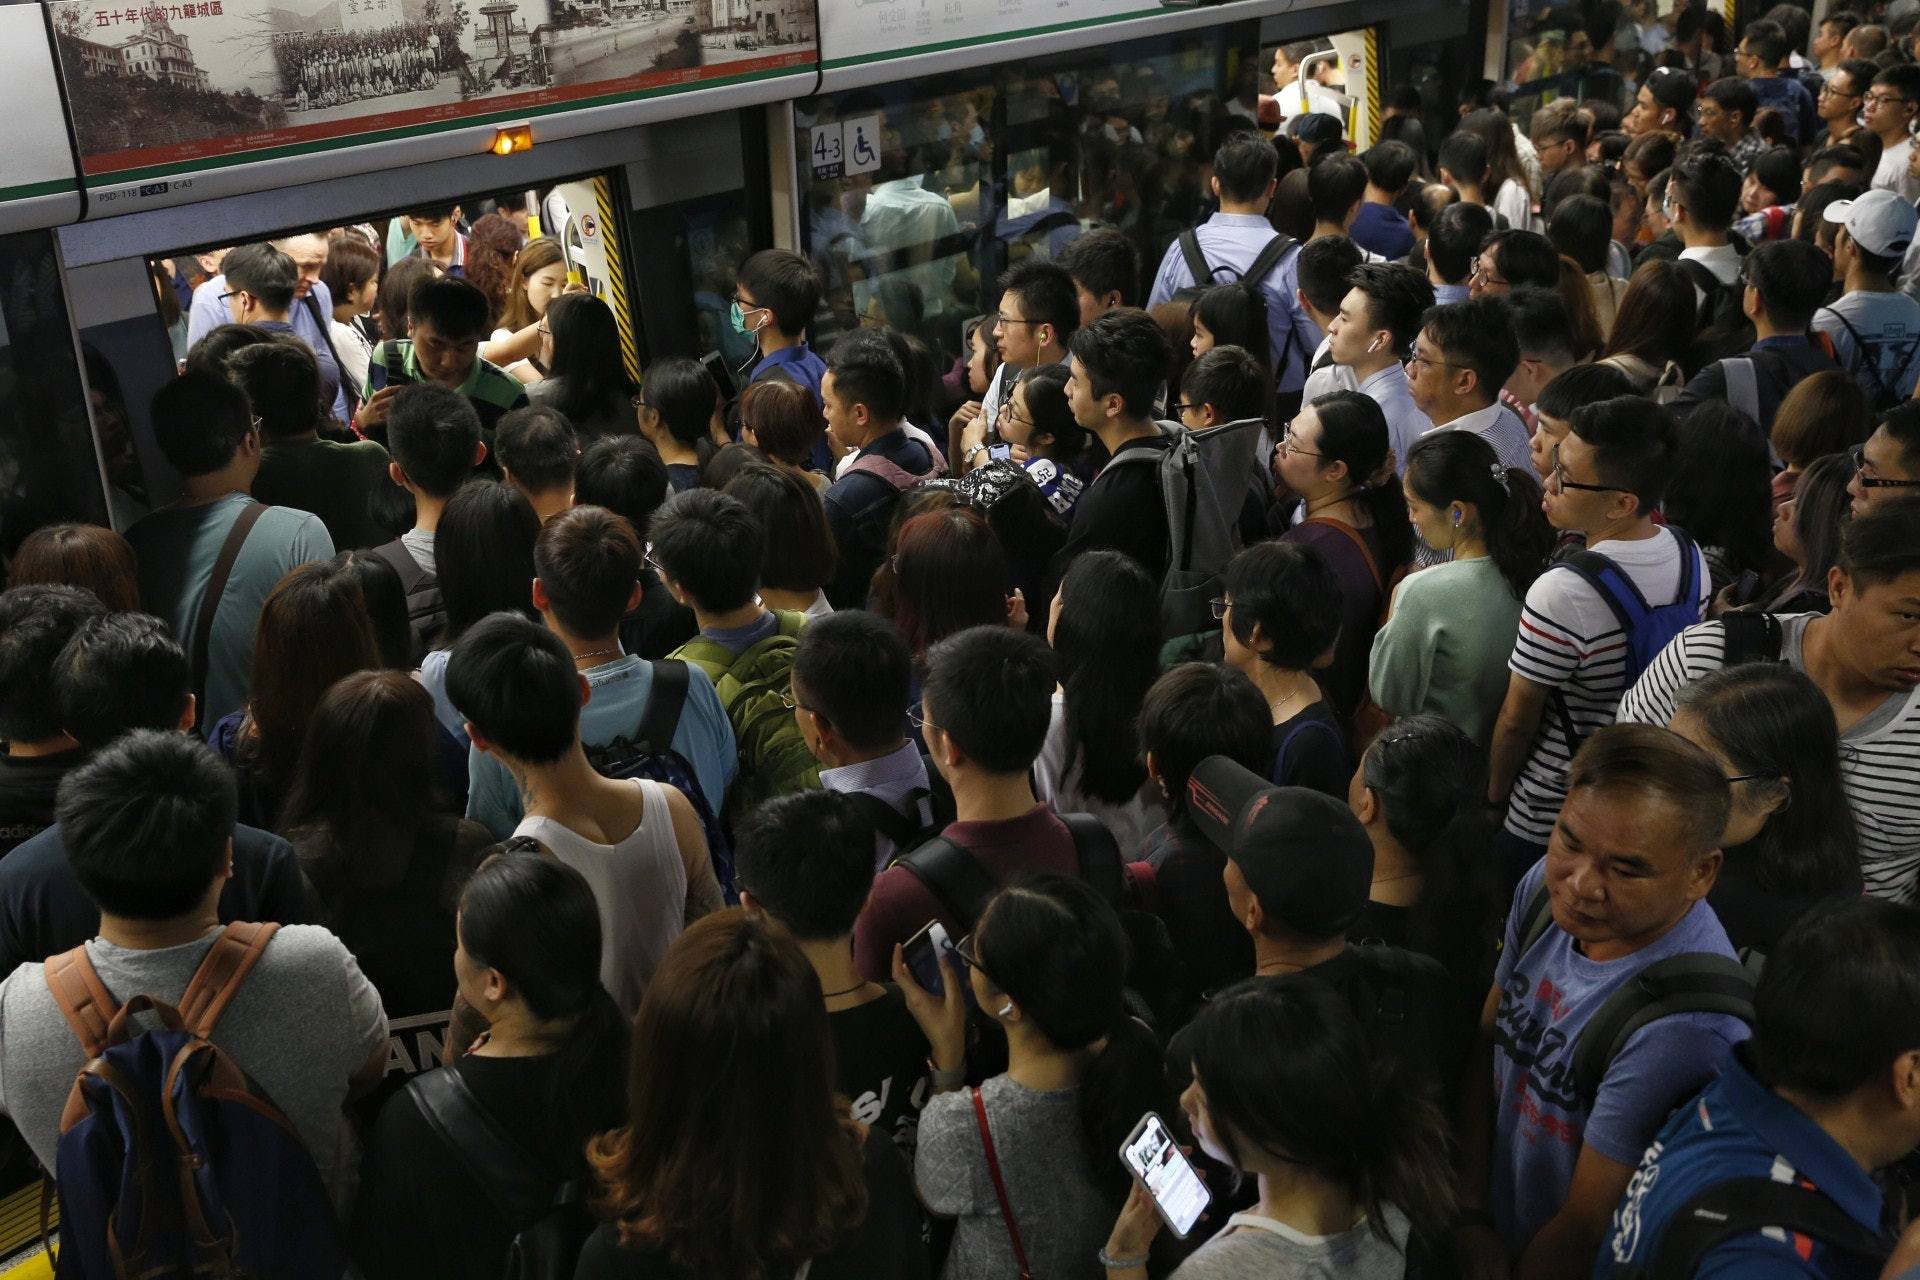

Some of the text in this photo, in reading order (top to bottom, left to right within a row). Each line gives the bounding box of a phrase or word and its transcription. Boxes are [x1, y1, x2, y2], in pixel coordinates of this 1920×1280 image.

[94, 1, 223, 27] 五十年代的九龍城區
[814, 131, 841, 161] 4-3
[173, 178, 193, 190] C-A3
[98, 188, 137, 201] PSD-118
[592, 673, 622, 689] afuma
